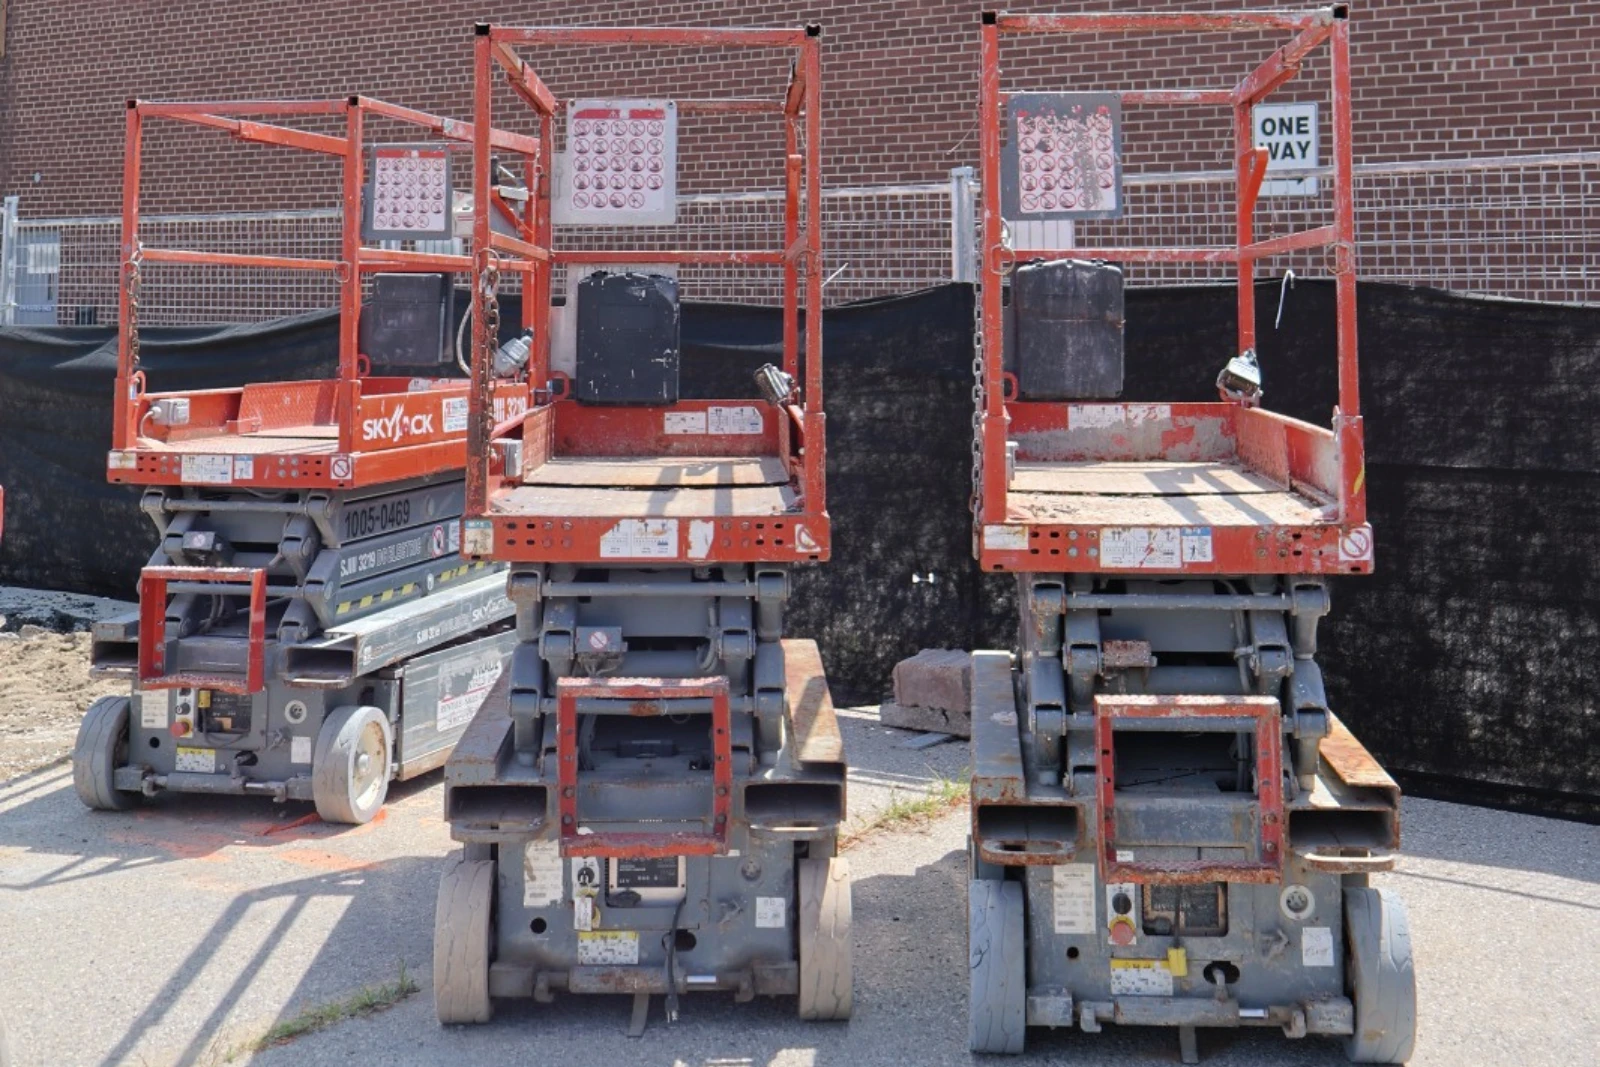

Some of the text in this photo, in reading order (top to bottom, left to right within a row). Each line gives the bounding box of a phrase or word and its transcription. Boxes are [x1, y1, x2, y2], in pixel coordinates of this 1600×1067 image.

[1261, 117, 1309, 136] ONE
[363, 404, 434, 442] SKYJACK
[345, 500, 410, 537] 1005-0469
[358, 551, 376, 572] 3219
